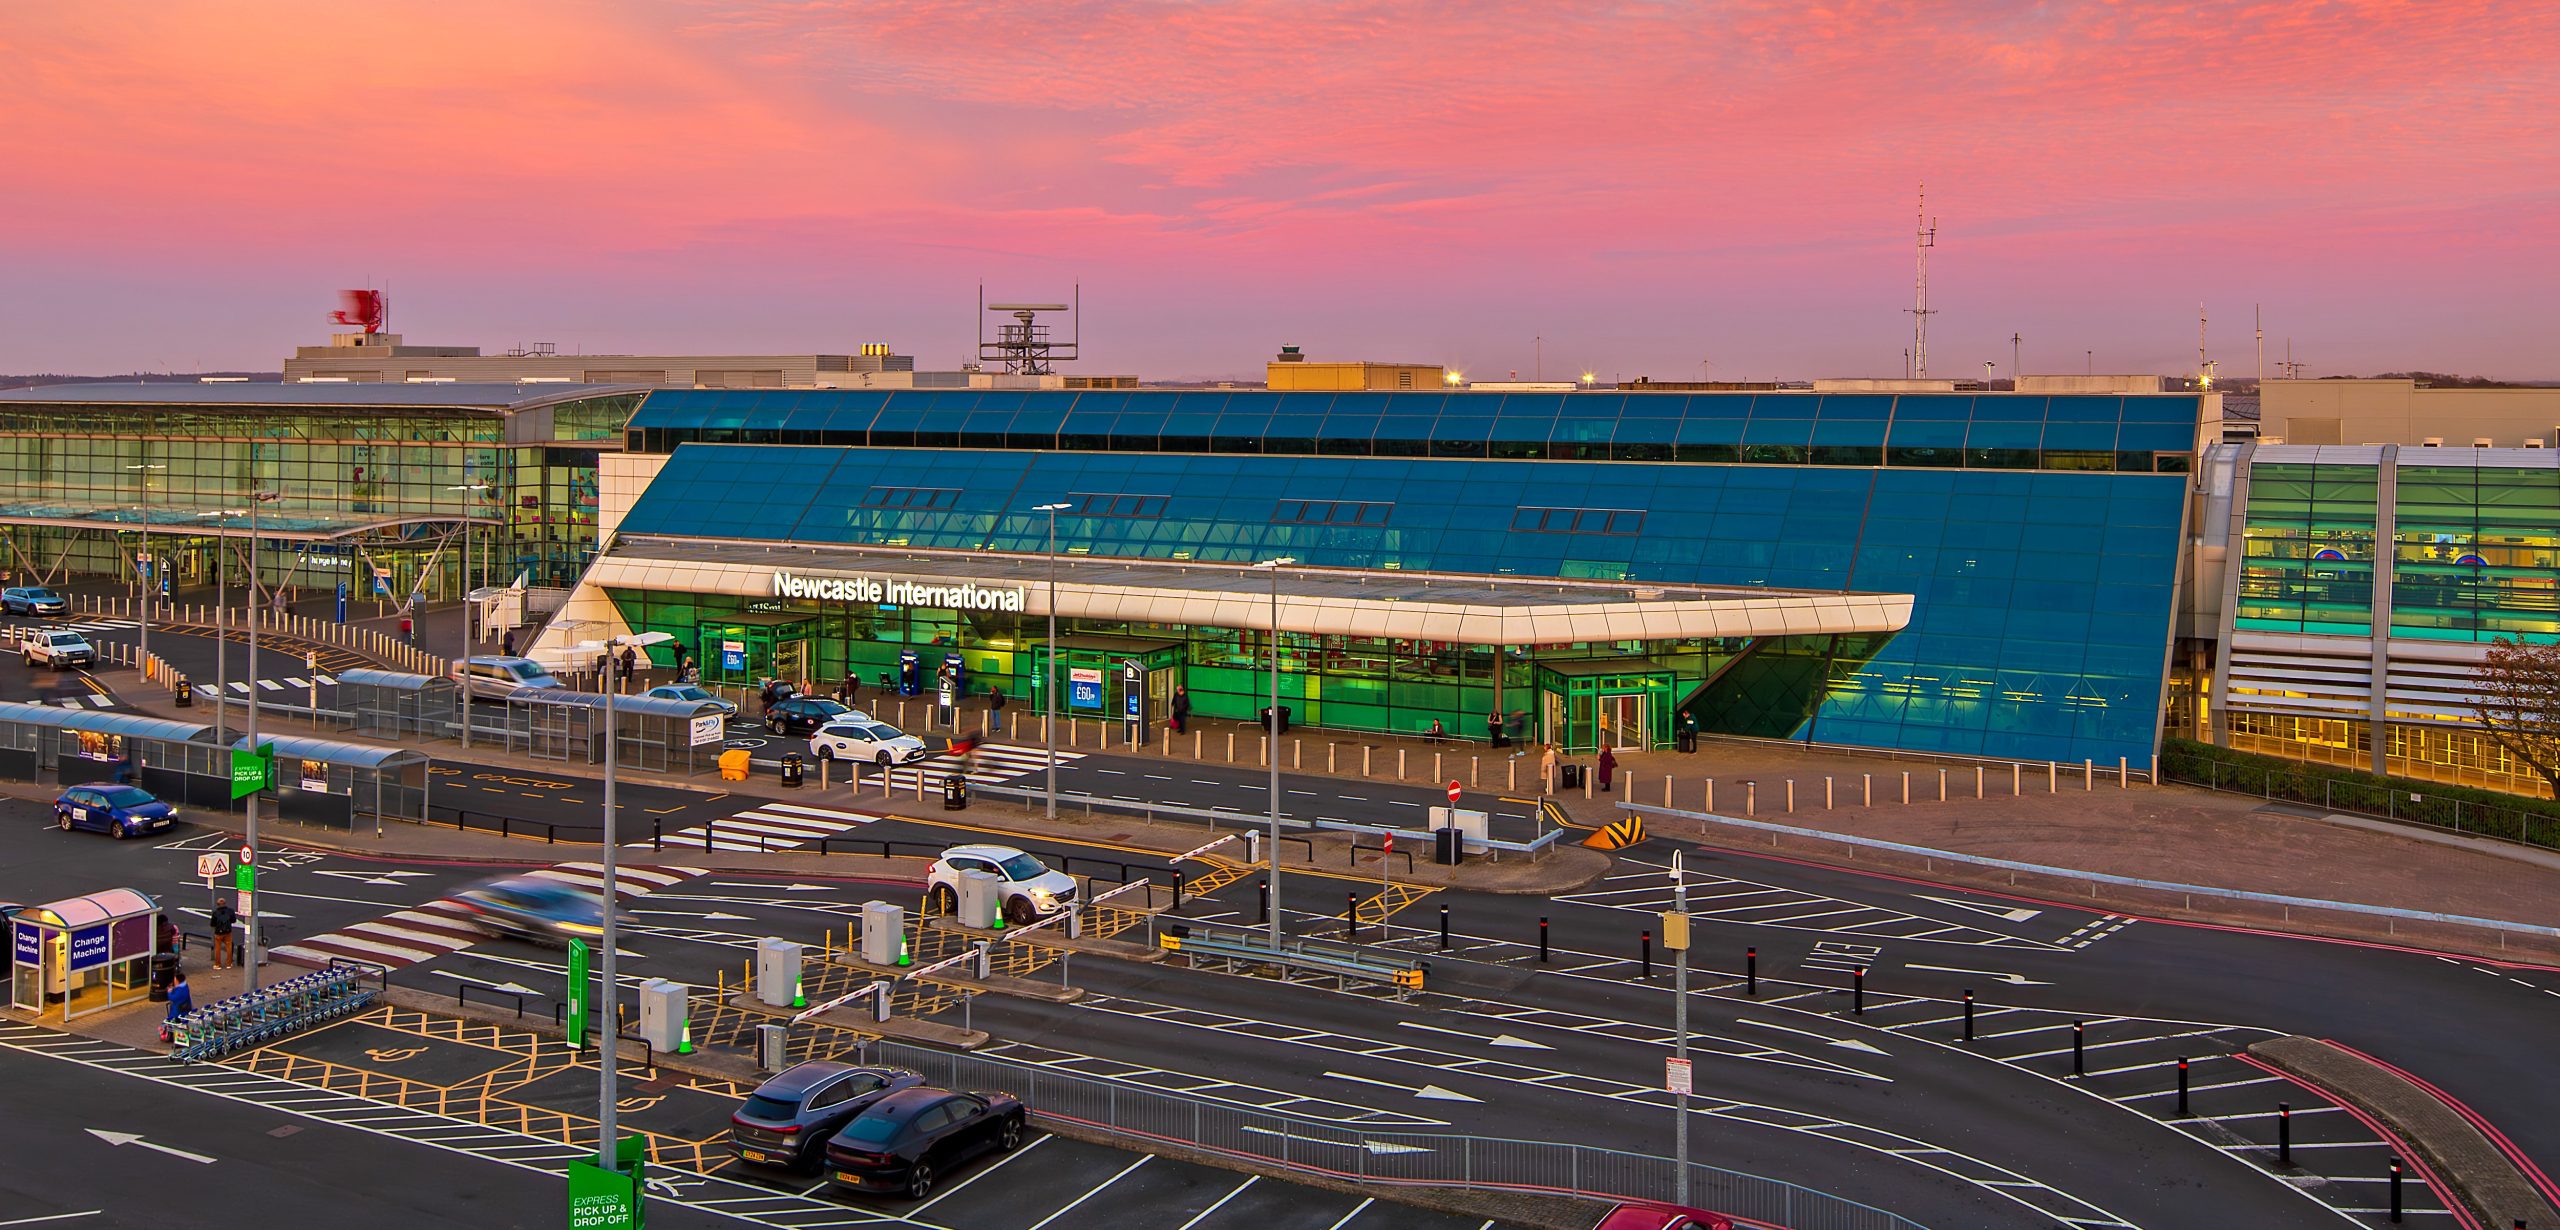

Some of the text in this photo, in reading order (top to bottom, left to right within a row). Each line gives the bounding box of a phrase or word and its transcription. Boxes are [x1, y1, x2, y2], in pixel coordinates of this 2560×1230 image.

[774, 572, 1025, 611] Newcastle International
[1127, 668, 1134, 678] B
[243, 850, 251, 860] 10
[18, 932, 38, 944] Change
[74, 934, 106, 948] Change
[17, 942, 39, 955] Machine
[73, 945, 107, 960] Machine
[573, 1194, 619, 1207] EXPRESS
[573, 1203, 627, 1217] PICK UP &
[573, 1214, 629, 1228] DROP OFF
